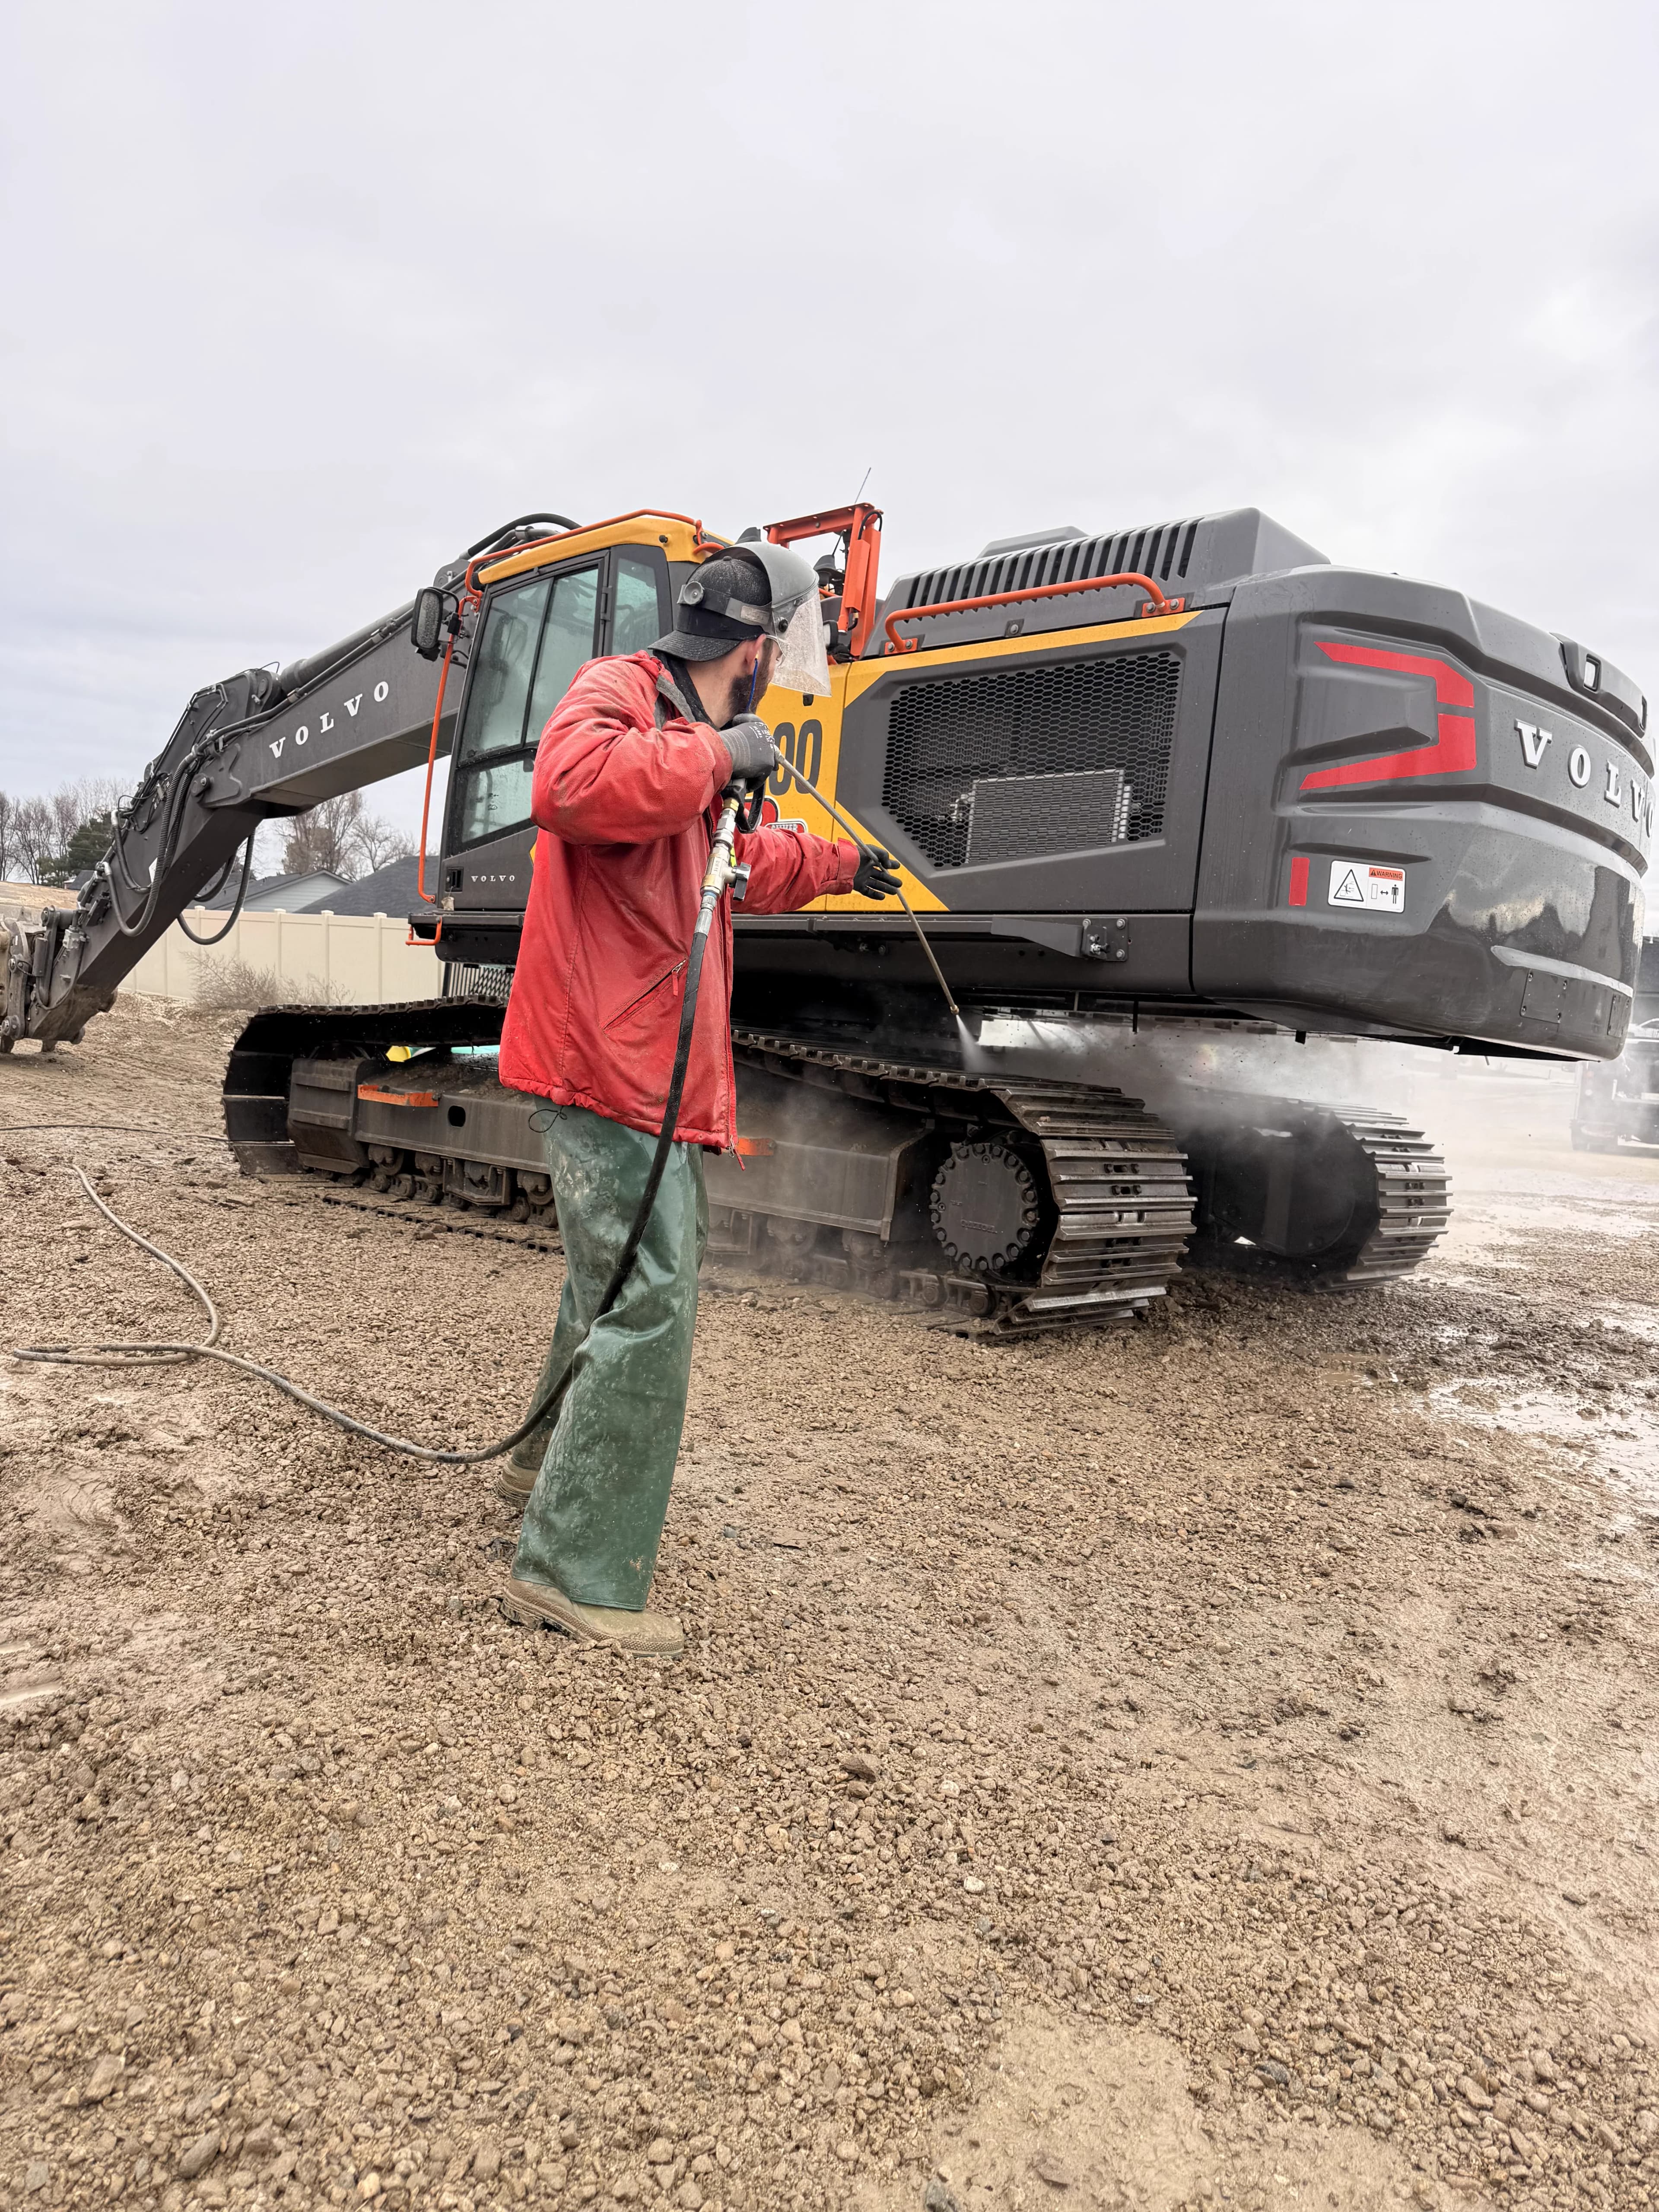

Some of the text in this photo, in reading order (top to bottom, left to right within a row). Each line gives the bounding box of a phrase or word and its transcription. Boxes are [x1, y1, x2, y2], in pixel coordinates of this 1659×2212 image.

[269, 681, 389, 758] VOLVO
[1514, 718, 1654, 838] VOLVO
[1376, 870, 1402, 879] WARNING
